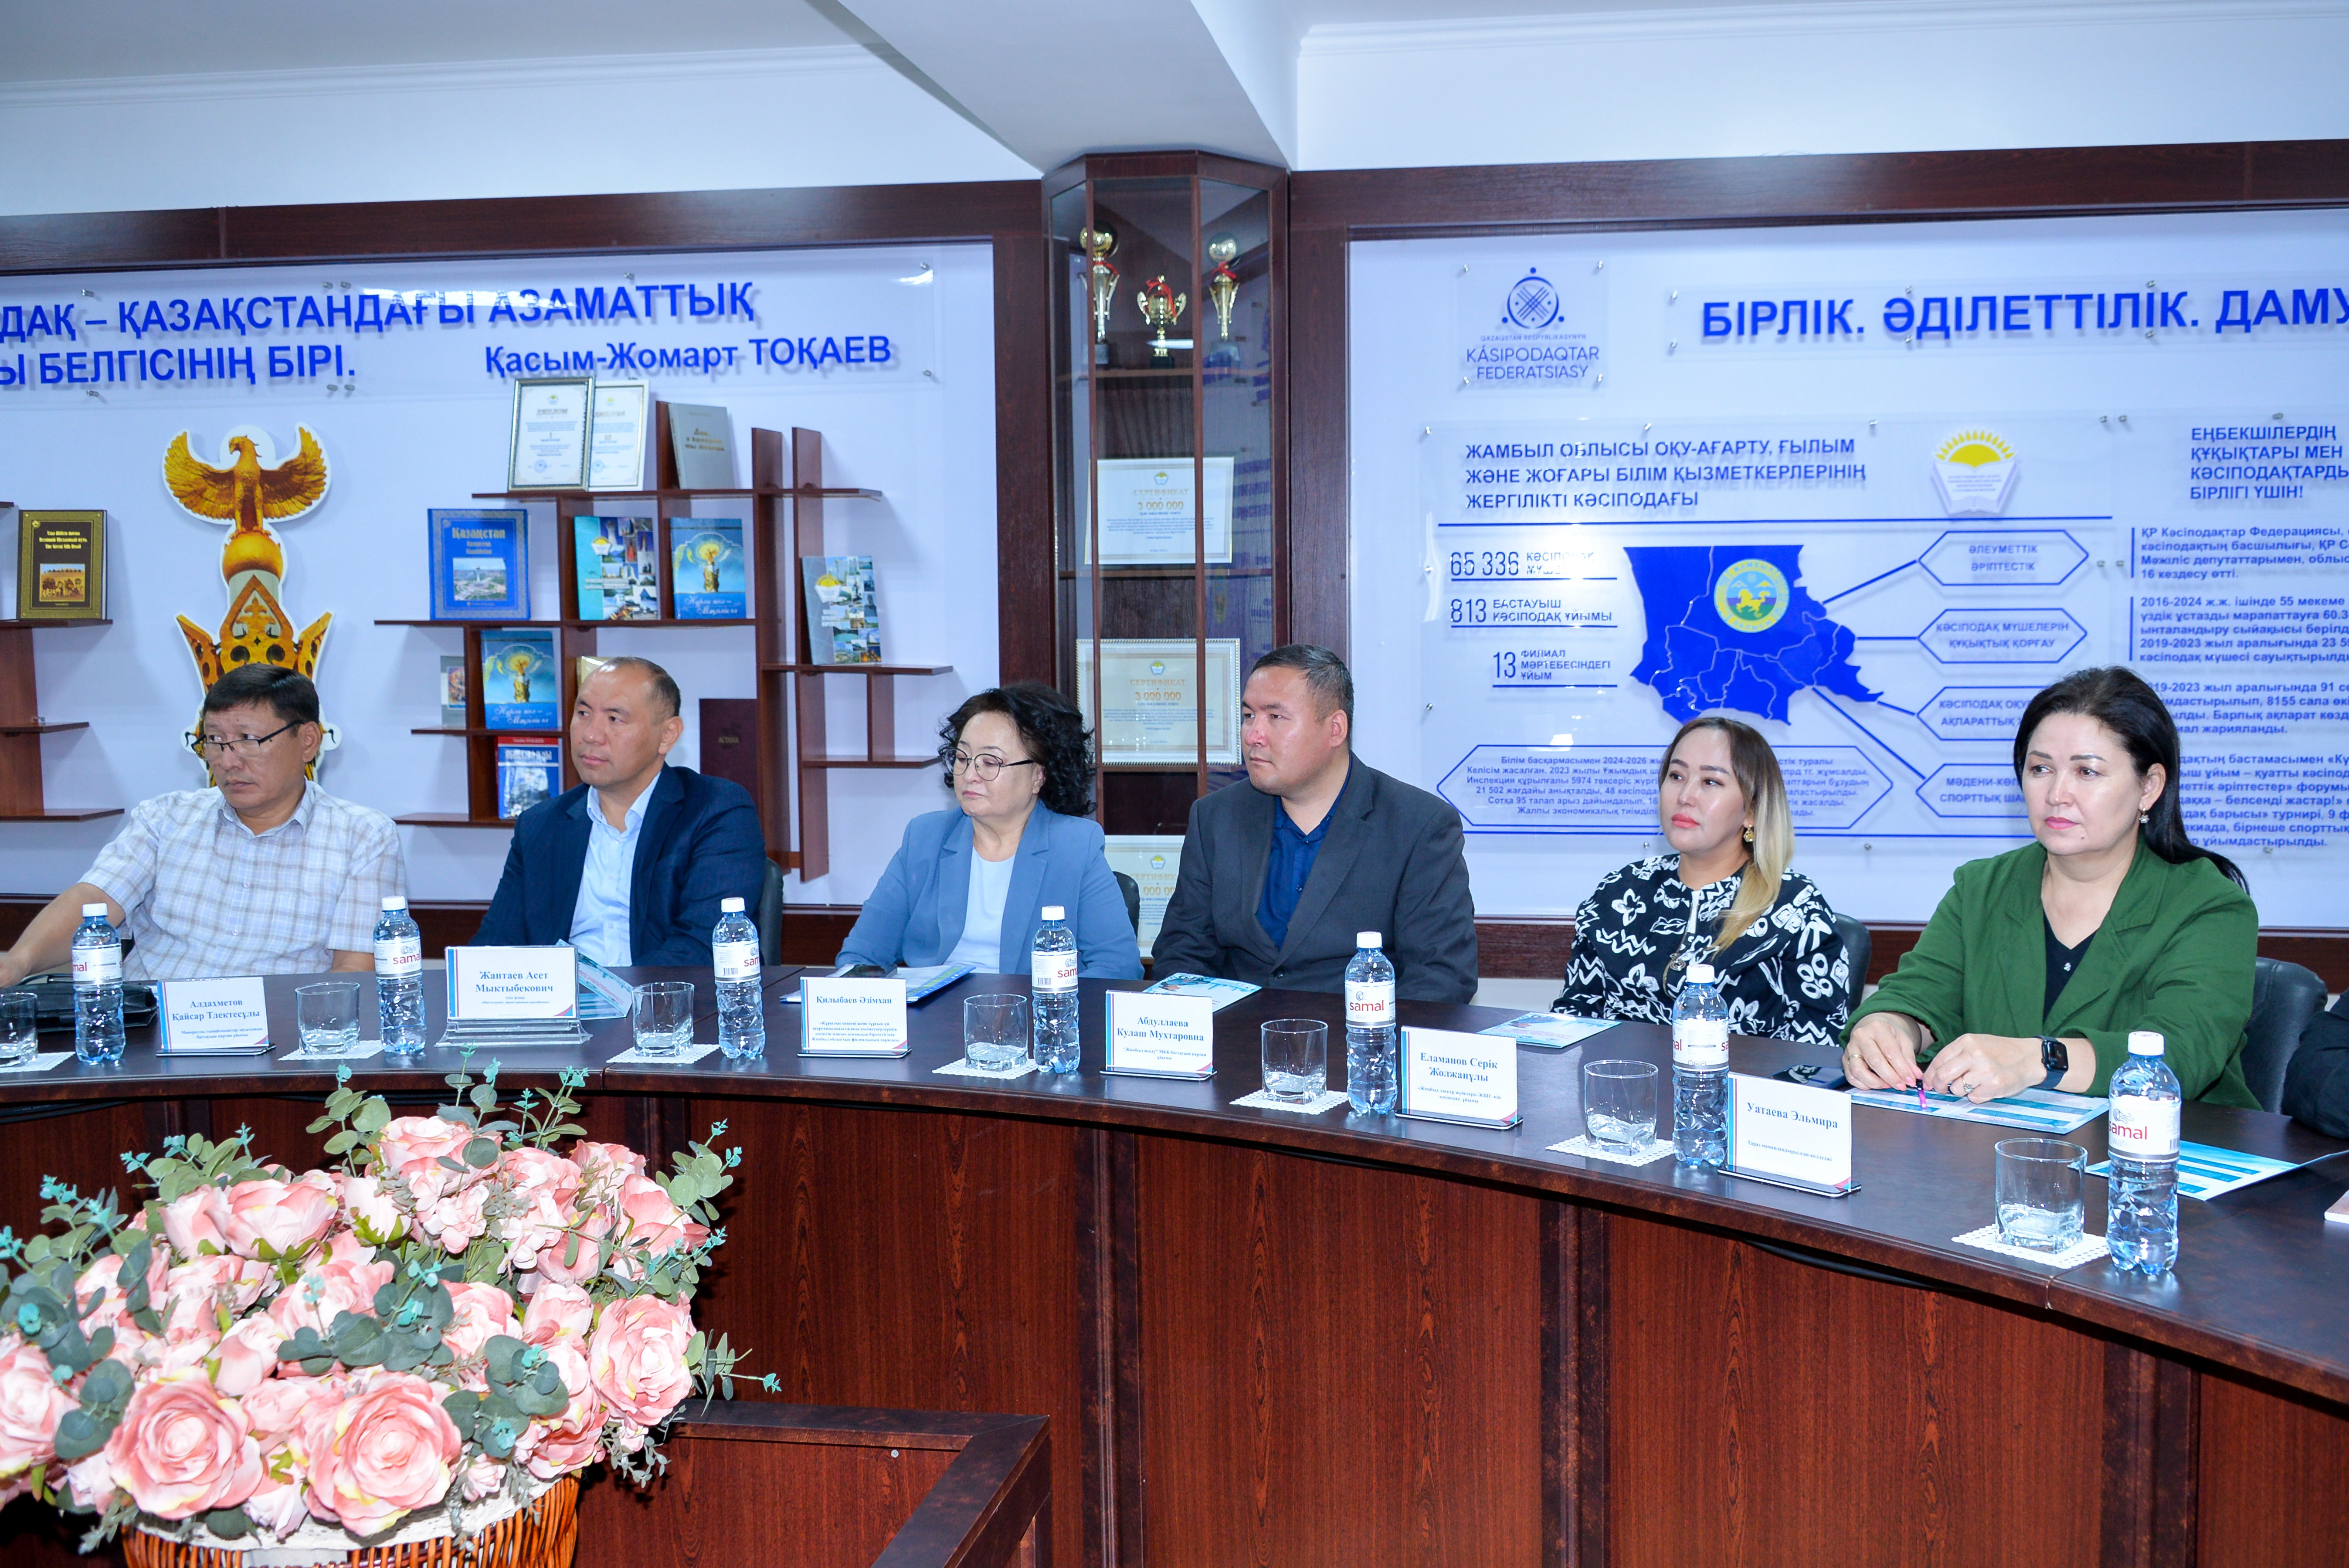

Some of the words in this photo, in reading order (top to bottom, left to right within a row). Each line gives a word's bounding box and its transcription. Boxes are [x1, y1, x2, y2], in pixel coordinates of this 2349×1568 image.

[0, 302, 76, 343] ДАҚ
[119, 294, 475, 339] ҚАЗАҚСТАНДАҒЫ
[489, 282, 754, 323] АЗАМАТТЫҚ
[1702, 299, 1865, 338] БІРЛІК.
[1884, 291, 2199, 339] ӘДІЛЕТТІЛІК.
[485, 342, 738, 377] Қасым-Жомарт
[748, 336, 890, 370] ТОҚАЕВ
[1466, 345, 1599, 363] KÁSIPODAQTAR
[40, 347, 256, 385] БЕЛГІСІНІҢ
[269, 345, 355, 378] БІРІ.
[1477, 365, 1589, 379] FEDERATSIASY
[2191, 425, 2336, 443] ЕҢБЕКШІЛЕРДІҢ
[1466, 443, 1554, 459] ЖАМБЫЛ
[1560, 441, 1649, 458] ОБЛЫСЫ
[1655, 440, 1772, 457] ОҚУ-АҒАРТУ,
[1778, 439, 1855, 455] ҒЫЛЫМ
[2191, 446, 2298, 462] ҚҰҚЫҚТАРЫ
[2305, 446, 2342, 460] МЕН
[1466, 468, 1520, 484] ЖӘНЕ
[1527, 467, 1609, 483] ЖОҒАРЫ
[1616, 467, 1667, 482] БІЛІМ
[1673, 464, 1865, 483] ҚЫЗМЕТКЕРЛЕРІНІҢ
[2190, 485, 2249, 500] БІРЛІГІ
[2254, 484, 2304, 499] ҮШІН!
[1147, 502, 1164, 510] 000
[1167, 501, 1184, 509] 000
[1466, 494, 1567, 509] ЖЕРГІЛІКТІ
[1573, 492, 1698, 508] КӘСІПОДАҒЫ
[2142, 528, 2157, 538] ҚР
[2162, 527, 2246, 538] Кәсіподақтар
[2250, 526, 2344, 538] Федерациясы,
[1969, 545, 2037, 554] ӘЛЕУМЕТТІК
[2141, 542, 2228, 553] кәсіподақтың
[2231, 540, 2315, 551] басшылығы,
[2319, 540, 2335, 550] ҚР
[1450, 552, 1474, 576] 65
[1482, 552, 1519, 576] 336
[2141, 554, 2189, 566] Мәжіліс
[2193, 555, 2305, 566] депутаттарымен,
[1971, 563, 2035, 571] ӘРІПТЕСТІК
[2142, 569, 2155, 578] 16
[2159, 571, 2206, 580] кездесу
[2212, 568, 2239, 578] өтті.
[1493, 599, 1561, 608] БАСТАУЫШ
[2141, 597, 2202, 607] 2016-2024
[2235, 597, 2275, 608] ішінде
[2280, 597, 2294, 606] 55
[1451, 599, 1486, 623] 813
[1493, 612, 1561, 623] КӘСІПОДАҚ
[1565, 609, 1612, 621] ҰЙЫМЫ
[2141, 611, 2172, 623] үздік
[2176, 612, 2229, 623] ұстазды
[2233, 611, 2319, 622] марапаттауға
[1936, 624, 1999, 633] КӘСІПОДАҚ
[2003, 623, 2069, 632] МҮШЕЛЕРІН
[2141, 626, 2229, 636] ынталандыру
[2233, 624, 2302, 635] сыйақысы
[1949, 640, 2010, 649] ҚҰҚЫҚТЫҚ
[2013, 639, 2055, 648] ҚОРҒАУ
[2140, 639, 2201, 648] 2019-2023
[2205, 639, 2233, 648] жыл
[2237, 638, 2318, 649] аралығында
[2322, 638, 2337, 647] 23
[2140, 652, 2201, 663] кәсіподақ
[2205, 652, 2250, 663] мүшесі
[1493, 652, 1516, 679] 13
[1521, 661, 1610, 670] МӘРТЕБЕСІНДЕГІ
[2204, 684, 2232, 692] жыл
[2236, 683, 2317, 693] аралығында
[2321, 682, 2334, 692] 91
[1144, 692, 1161, 700] 000
[2267, 696, 2295, 706] 8155
[2299, 698, 2329, 706] сала
[1940, 700, 2003, 709] КӘСІПОДАҚ
[2213, 710, 2263, 721] Барлық
[2266, 712, 2316, 721] ақпарат
[1941, 718, 2016, 727] АҚПАРАТТЫҚ
[2203, 725, 2287, 735] жарияланды.
[1528, 757, 1600, 766] басқармасымен
[2229, 754, 2323, 764] бастамасымен
[2205, 768, 2240, 779] ұйым
[2255, 769, 2298, 780] қуатты
[1467, 777, 1514, 785] Инспекция
[1594, 777, 1631, 786] тексеріс
[1506, 787, 1545, 795] жағдайы
[1548, 787, 1602, 796] анықталды,
[2218, 782, 2291, 793] әріптестер»
[1582, 797, 1645, 806] дайындалып,
[1940, 794, 2002, 803] СПОРТТЫҚ
[2226, 795, 2282, 806] белсенді
[2286, 795, 2342, 806] жастар!»
[1517, 807, 1550, 815] Жалпы
[1553, 808, 1619, 816] экономикалық
[2210, 809, 2268, 820] барысы»
[2272, 809, 2323, 821] турнирі,
[2329, 809, 2335, 818] 9
[2233, 822, 2285, 833] бірнеше
[2203, 836, 2327, 848] ұйымдастырылды.
[475, 984, 553, 992] Мыктыбекович
[190, 1000, 243, 1008] Алдахметов
[1350, 1000, 1384, 1011] samal
[207, 1011, 260, 1019] Тлектесұлы
[1137, 1017, 1188, 1027] Абдуллаева
[1117, 1028, 1146, 1038] Кулаш
[1150, 1030, 1204, 1042] Мухтаровна
[1420, 1052, 1467, 1066] Еламанов
[1470, 1058, 1497, 1069] Серік
[1429, 1067, 1488, 1082] Жолжанұлы
[1747, 1102, 1788, 1119] Уатаева
[1791, 1110, 1838, 1129] Эльмира
[2108, 1120, 2147, 1140] samal
